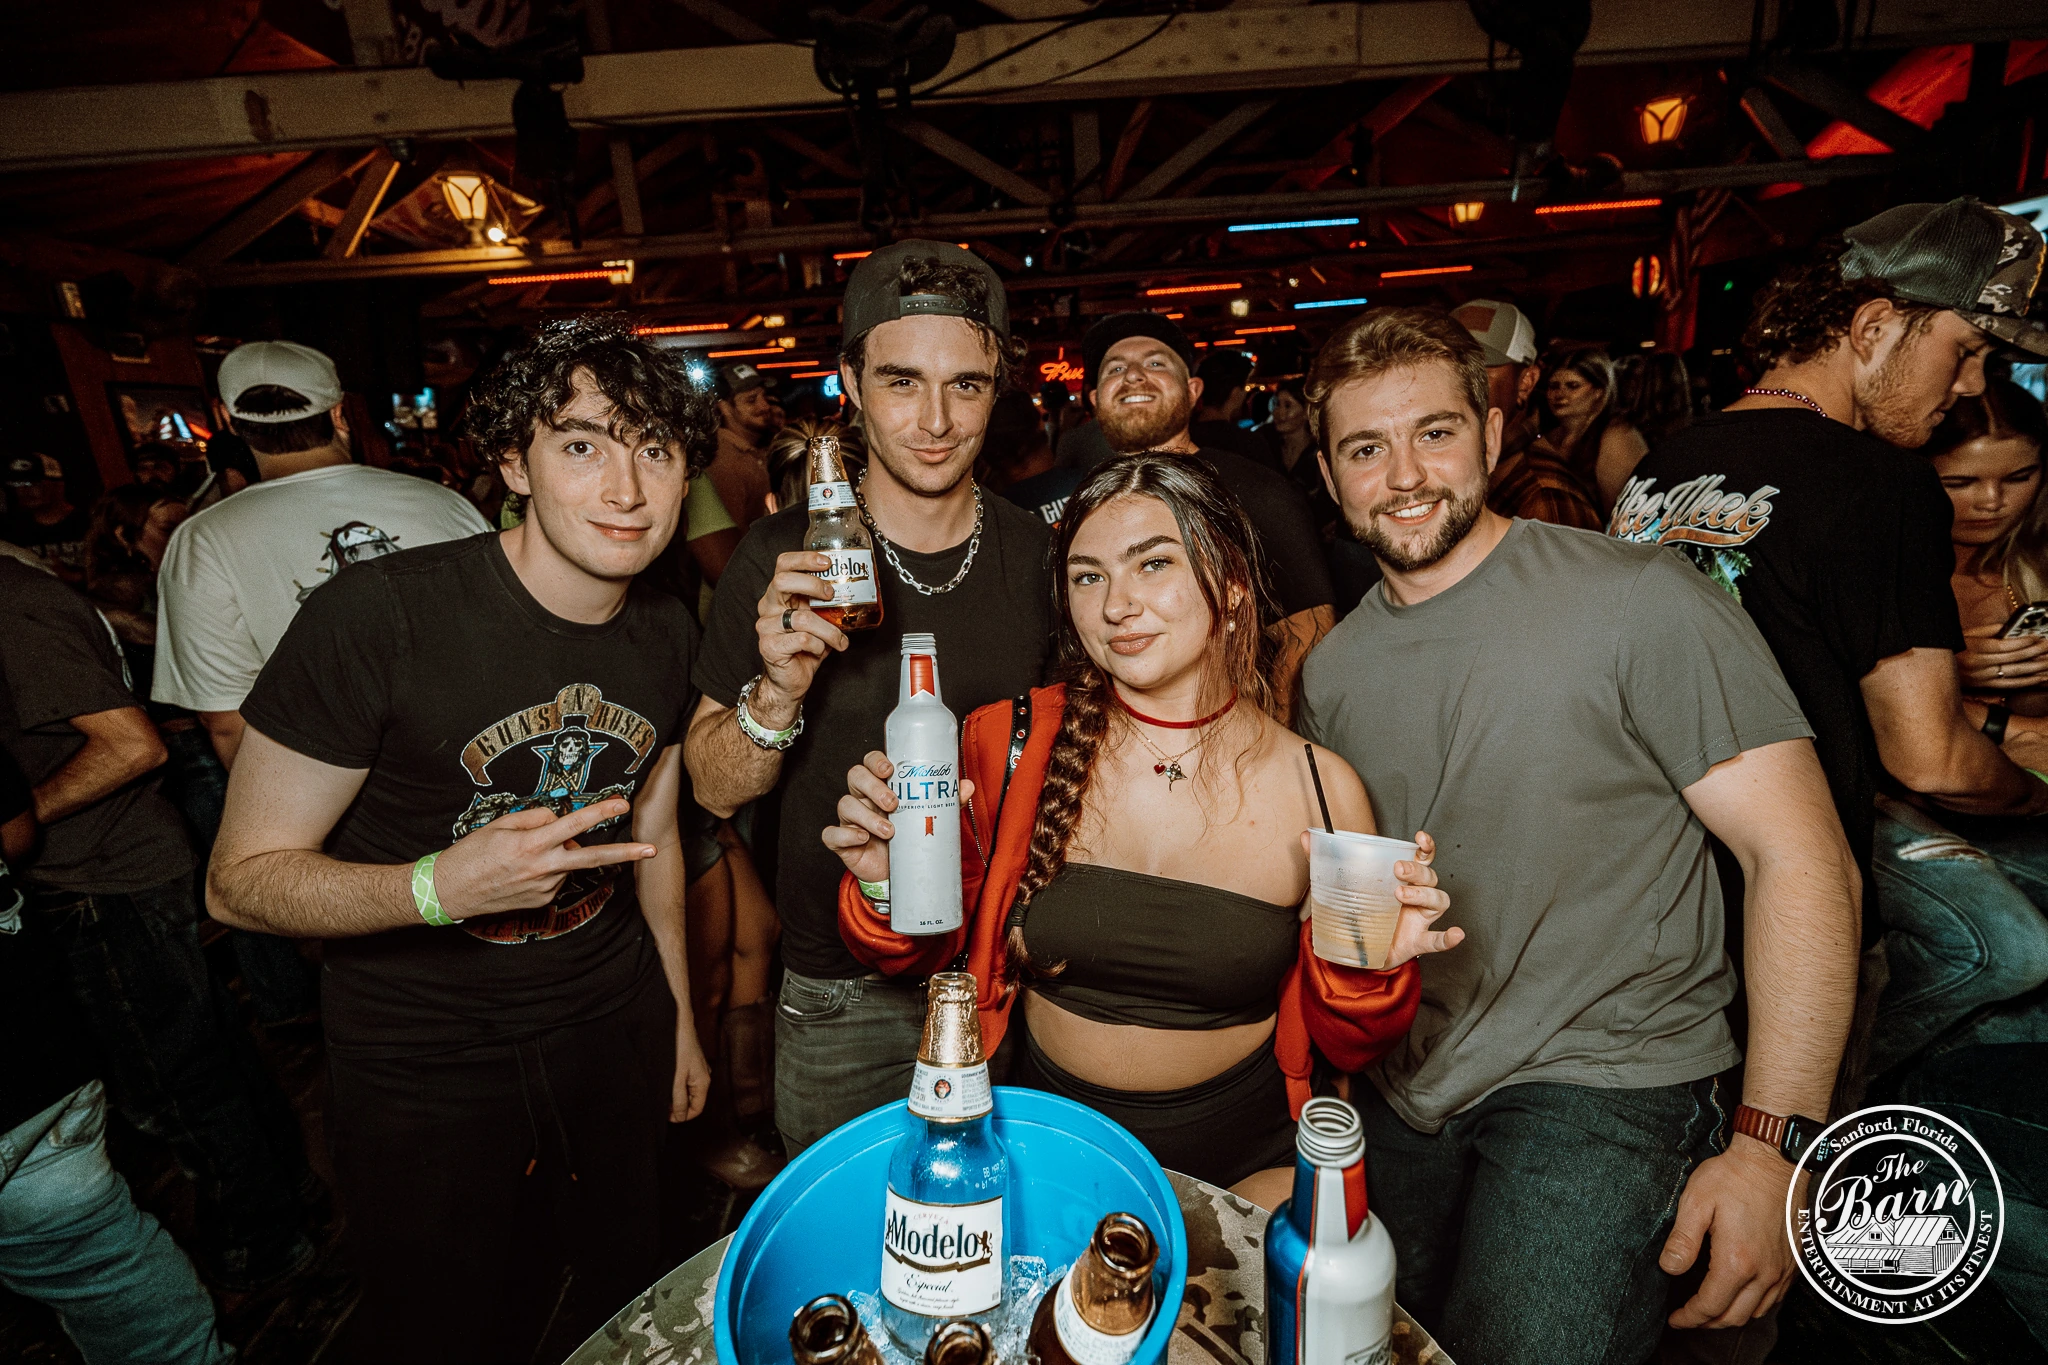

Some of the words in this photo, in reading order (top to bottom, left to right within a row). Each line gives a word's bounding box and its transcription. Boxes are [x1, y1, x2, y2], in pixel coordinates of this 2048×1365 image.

[1661, 473, 1780, 542] Week
[810, 557, 861, 578] odelo
[476, 707, 550, 757] GUNS
[595, 704, 653, 748] ROSES
[898, 763, 952, 779] Michelob
[891, 779, 959, 800] ULTRA
[890, 1208, 979, 1260] Modelo
[904, 1273, 952, 1293] Especial
